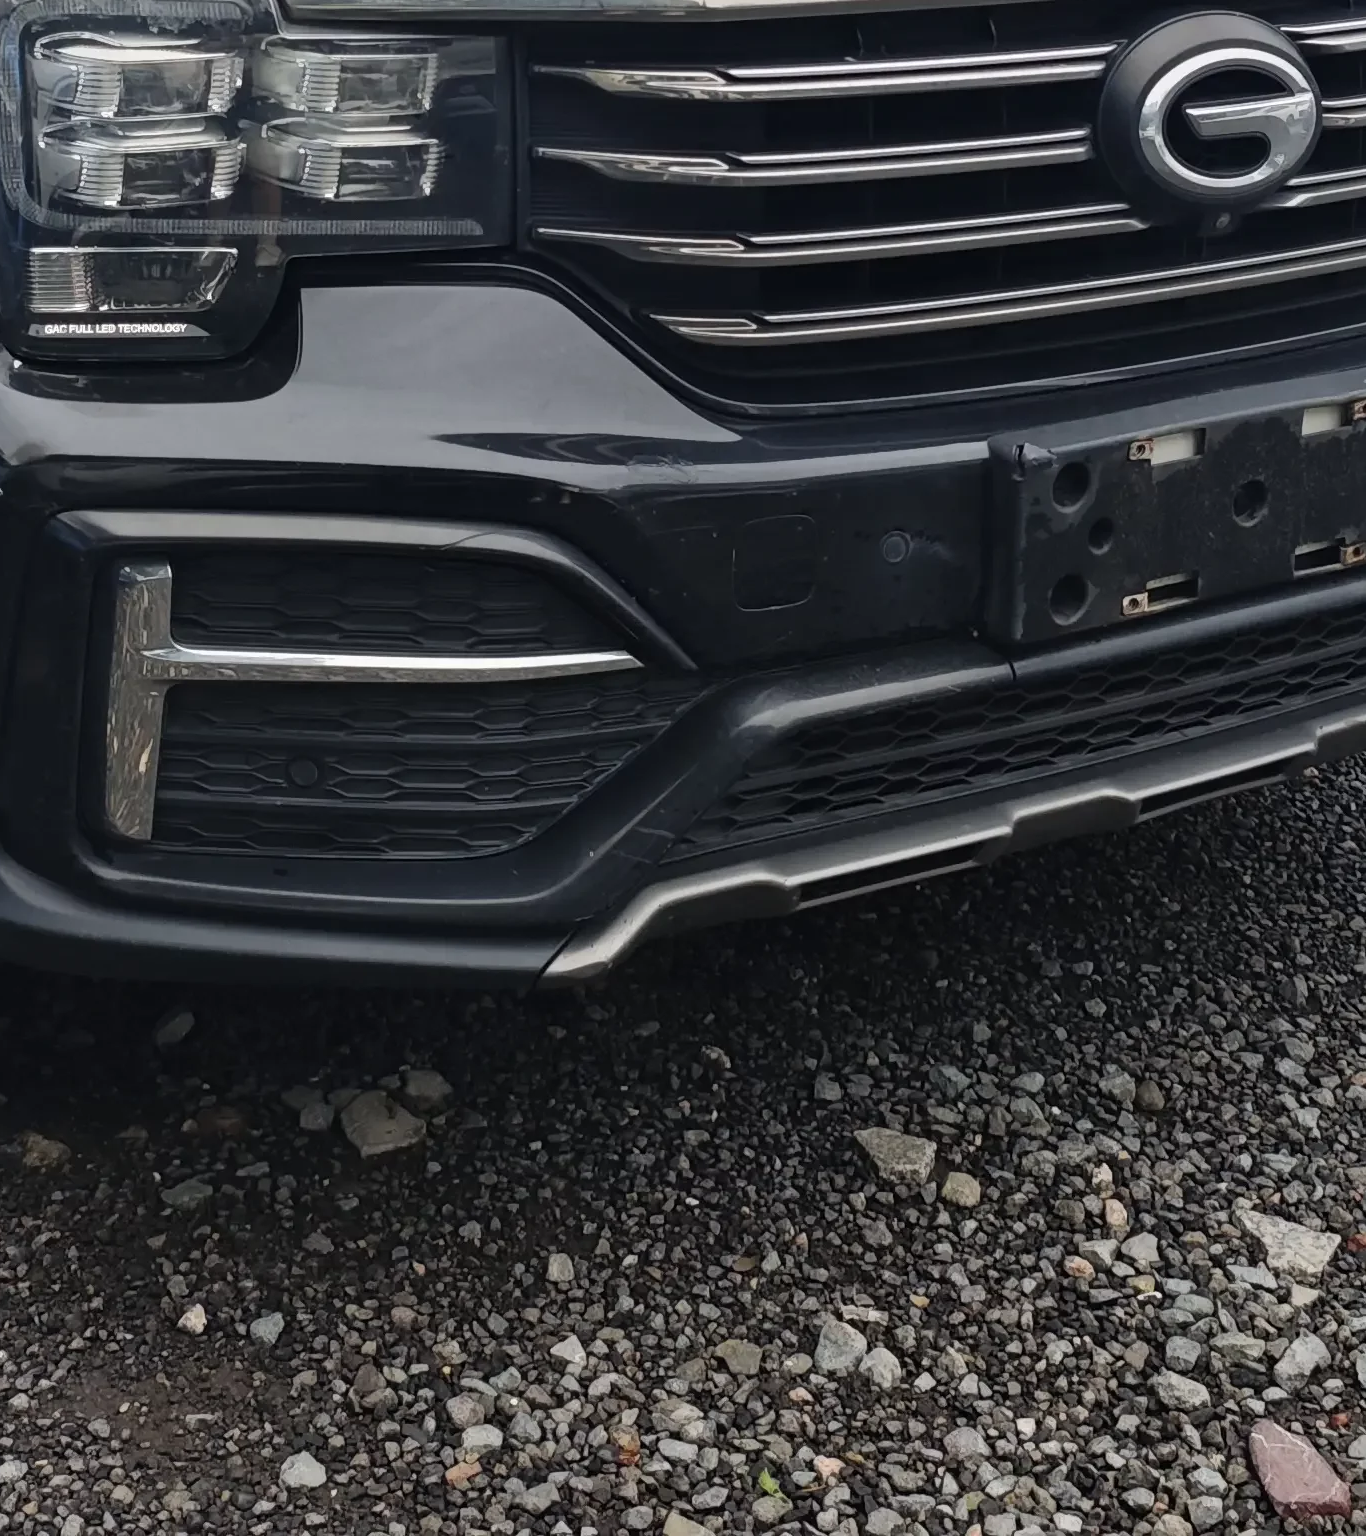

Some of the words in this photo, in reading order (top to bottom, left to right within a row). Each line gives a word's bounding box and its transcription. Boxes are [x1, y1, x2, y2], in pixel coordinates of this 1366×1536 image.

[44, 324, 68, 334] GAC
[68, 324, 94, 334] FULL
[95, 324, 116, 334] LED
[117, 323, 188, 333] TECHNOLOGY
